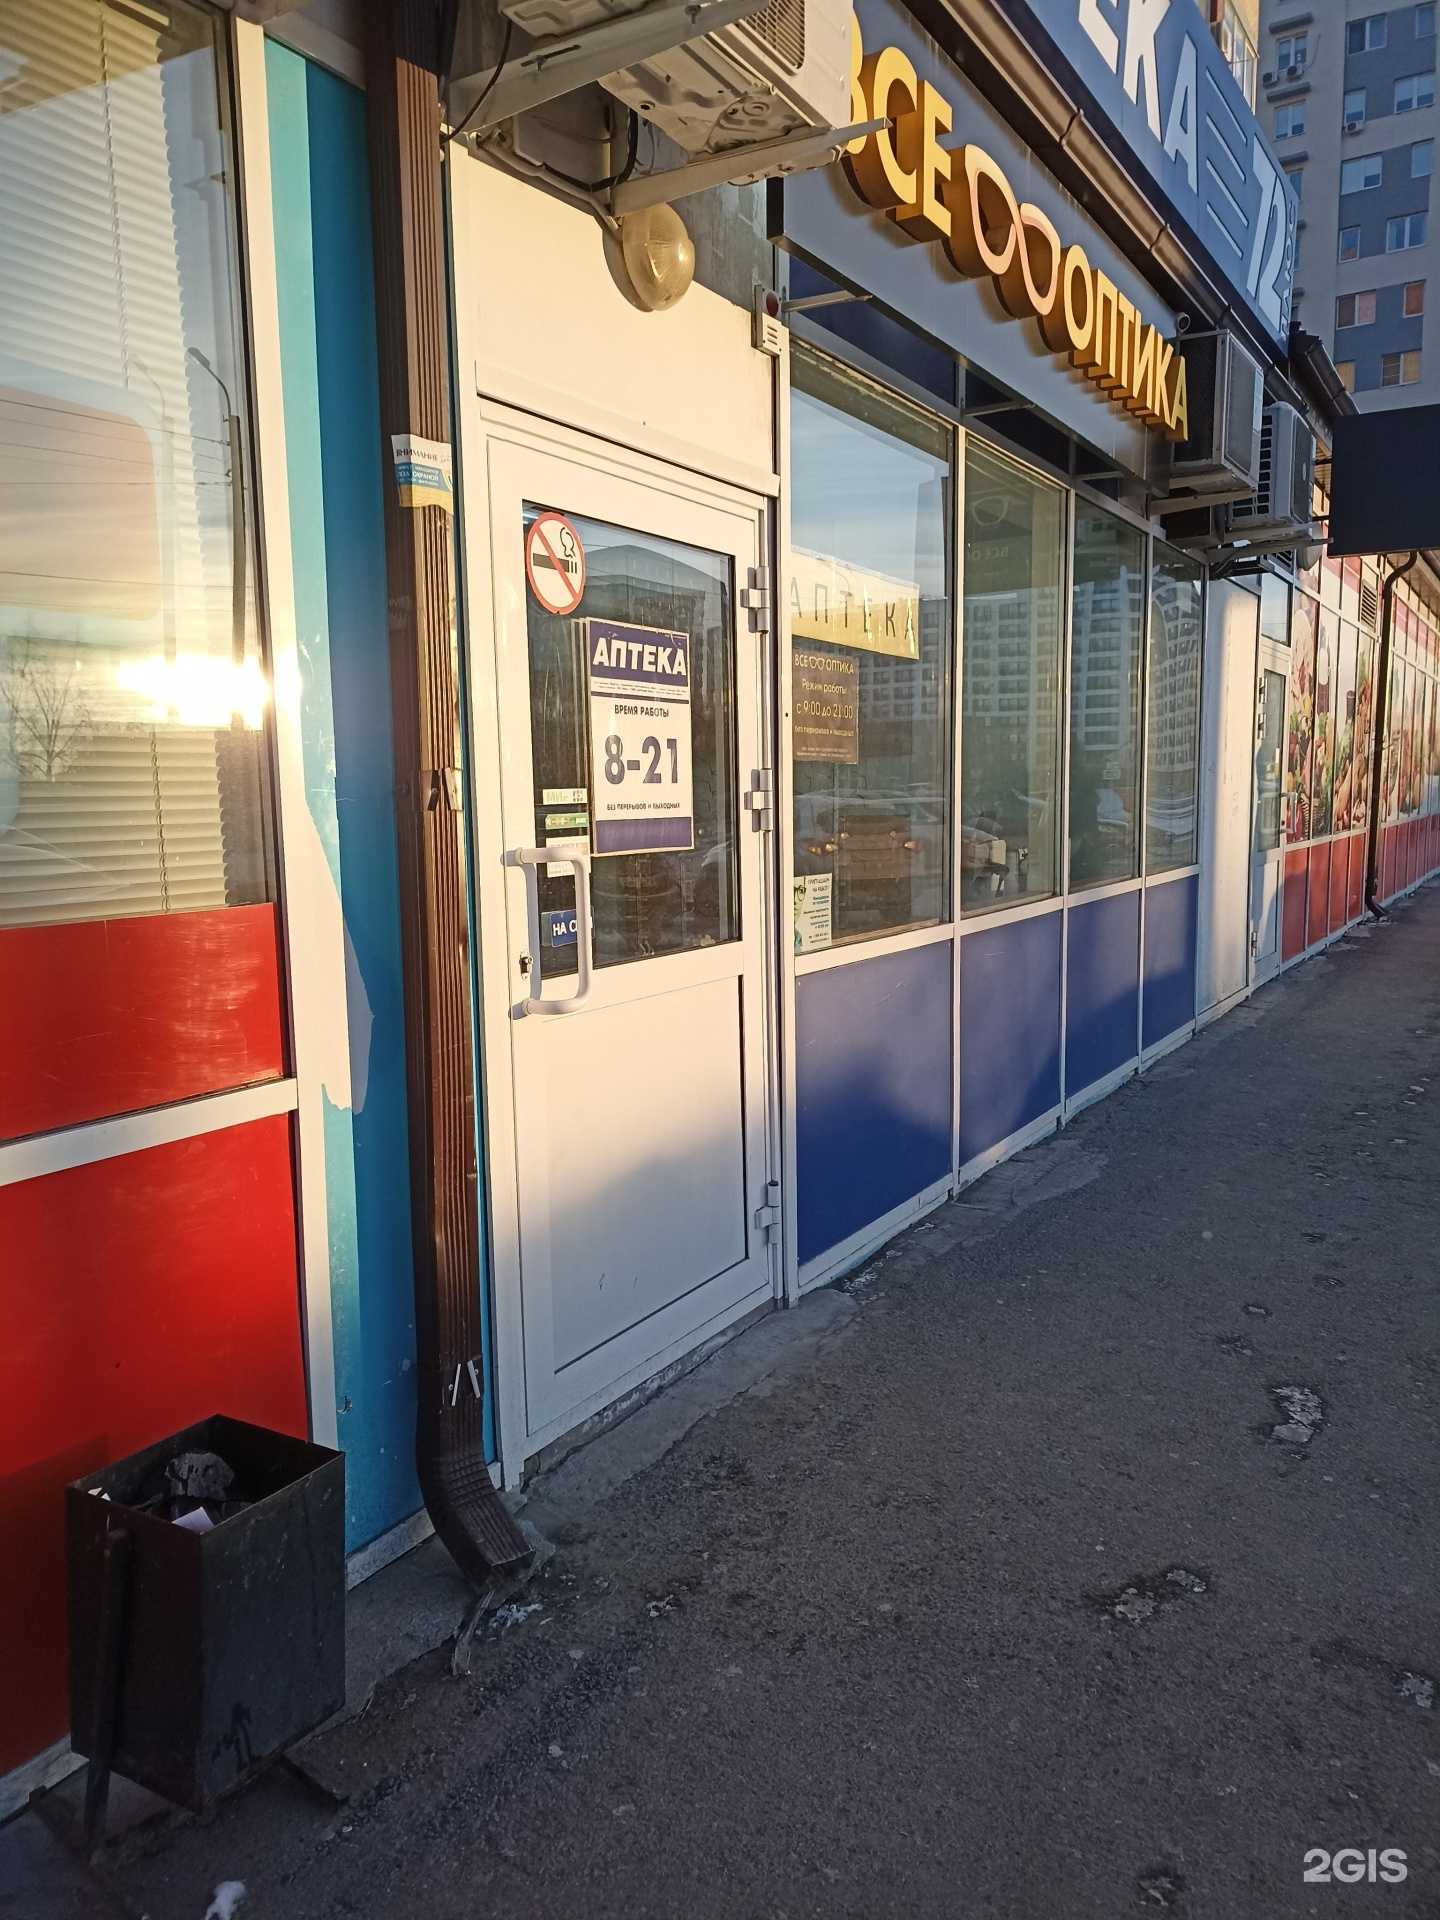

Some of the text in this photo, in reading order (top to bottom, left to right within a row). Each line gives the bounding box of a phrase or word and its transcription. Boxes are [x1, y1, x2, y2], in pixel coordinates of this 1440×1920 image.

[1064, 244, 1189, 441] ОПТИКА
[592, 637, 687, 675] АПТЕКА
[794, 654, 855, 674] ВСЕ ОПТИКА
[614, 704, 669, 717] ВРЕМЯ РАБОТЫ
[604, 734, 678, 785] 8-21
[552, 922, 567, 937] НА
